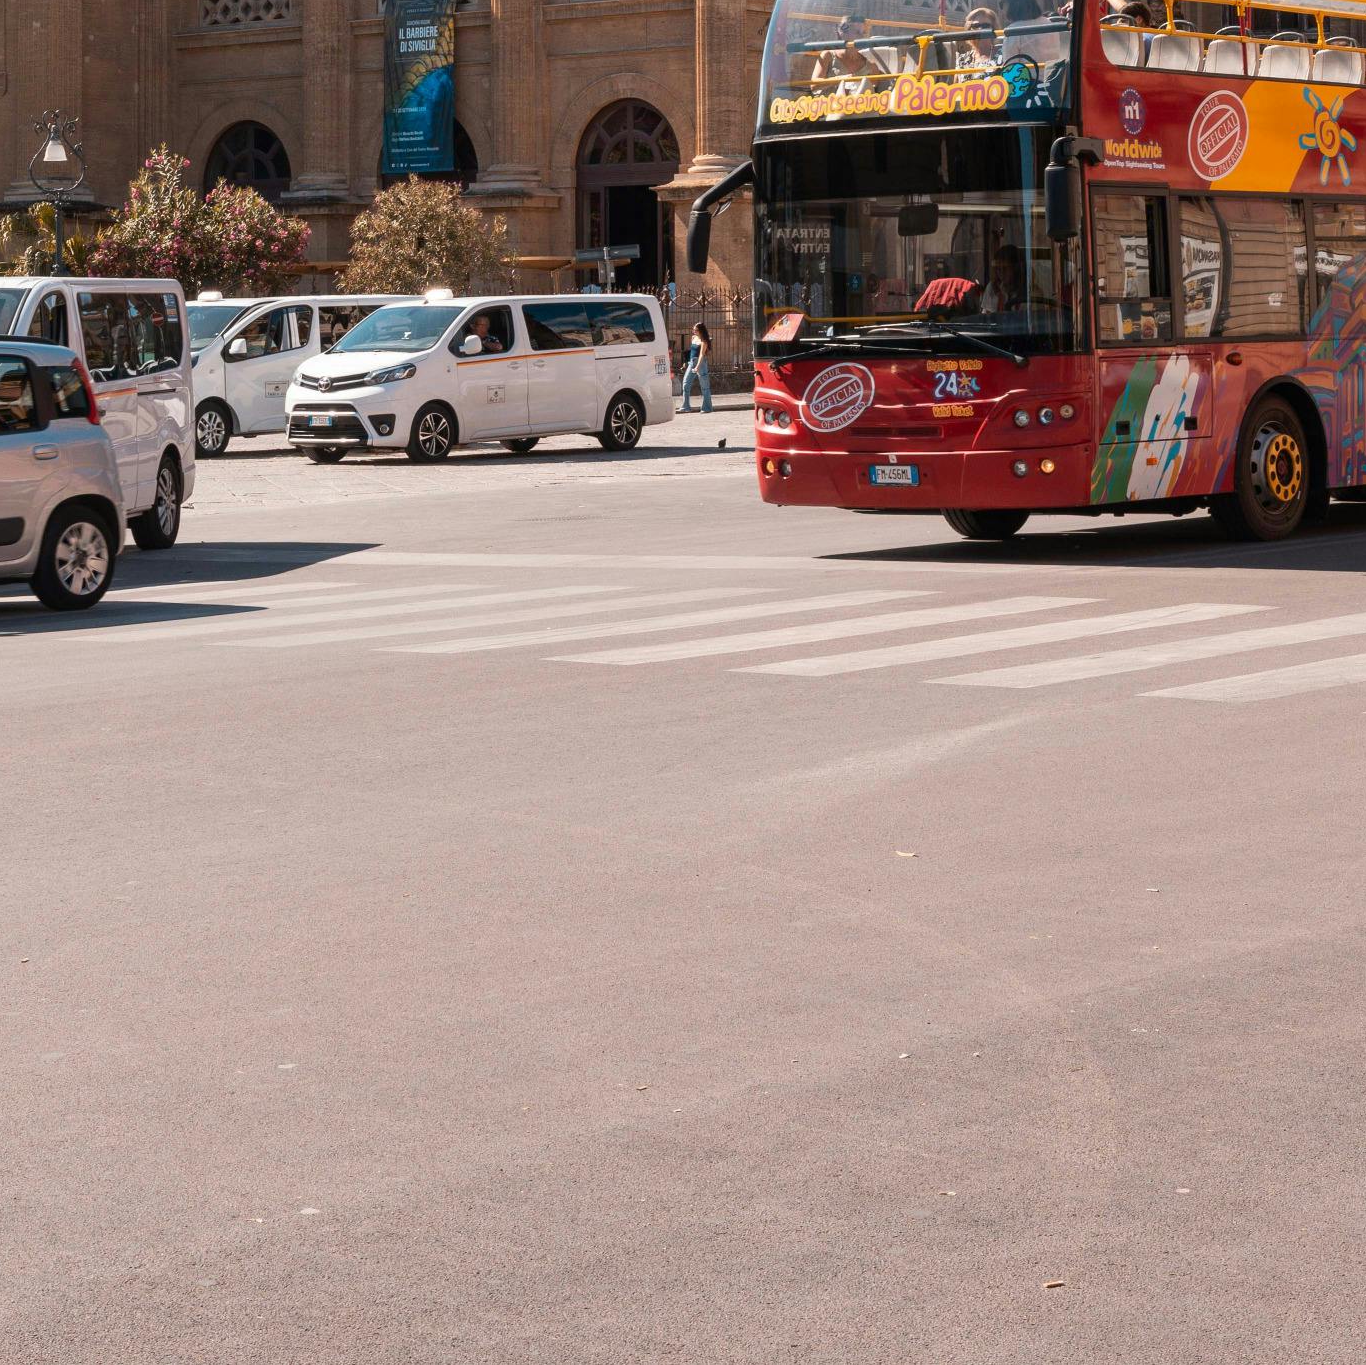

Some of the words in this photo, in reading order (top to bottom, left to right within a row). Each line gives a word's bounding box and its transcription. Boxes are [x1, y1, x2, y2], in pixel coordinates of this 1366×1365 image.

[399, 28, 405, 39] IL
[406, 26, 439, 39] BARBIERE
[400, 41, 407, 52] DI
[408, 39, 436, 52] SIVIGLIA
[894, 73, 1009, 115] Palermo
[1200, 96, 1220, 117] TOUR
[1200, 113, 1238, 157] OFFICIAL
[1105, 138, 1163, 159] Worldwide
[1208, 166, 1218, 177] OF
[1218, 139, 1243, 176] PALERMO
[817, 367, 842, 384] TOUR
[935, 372, 957, 397] 24
[812, 382, 861, 413] OFFICIAL
[833, 401, 866, 428] PALERMO
